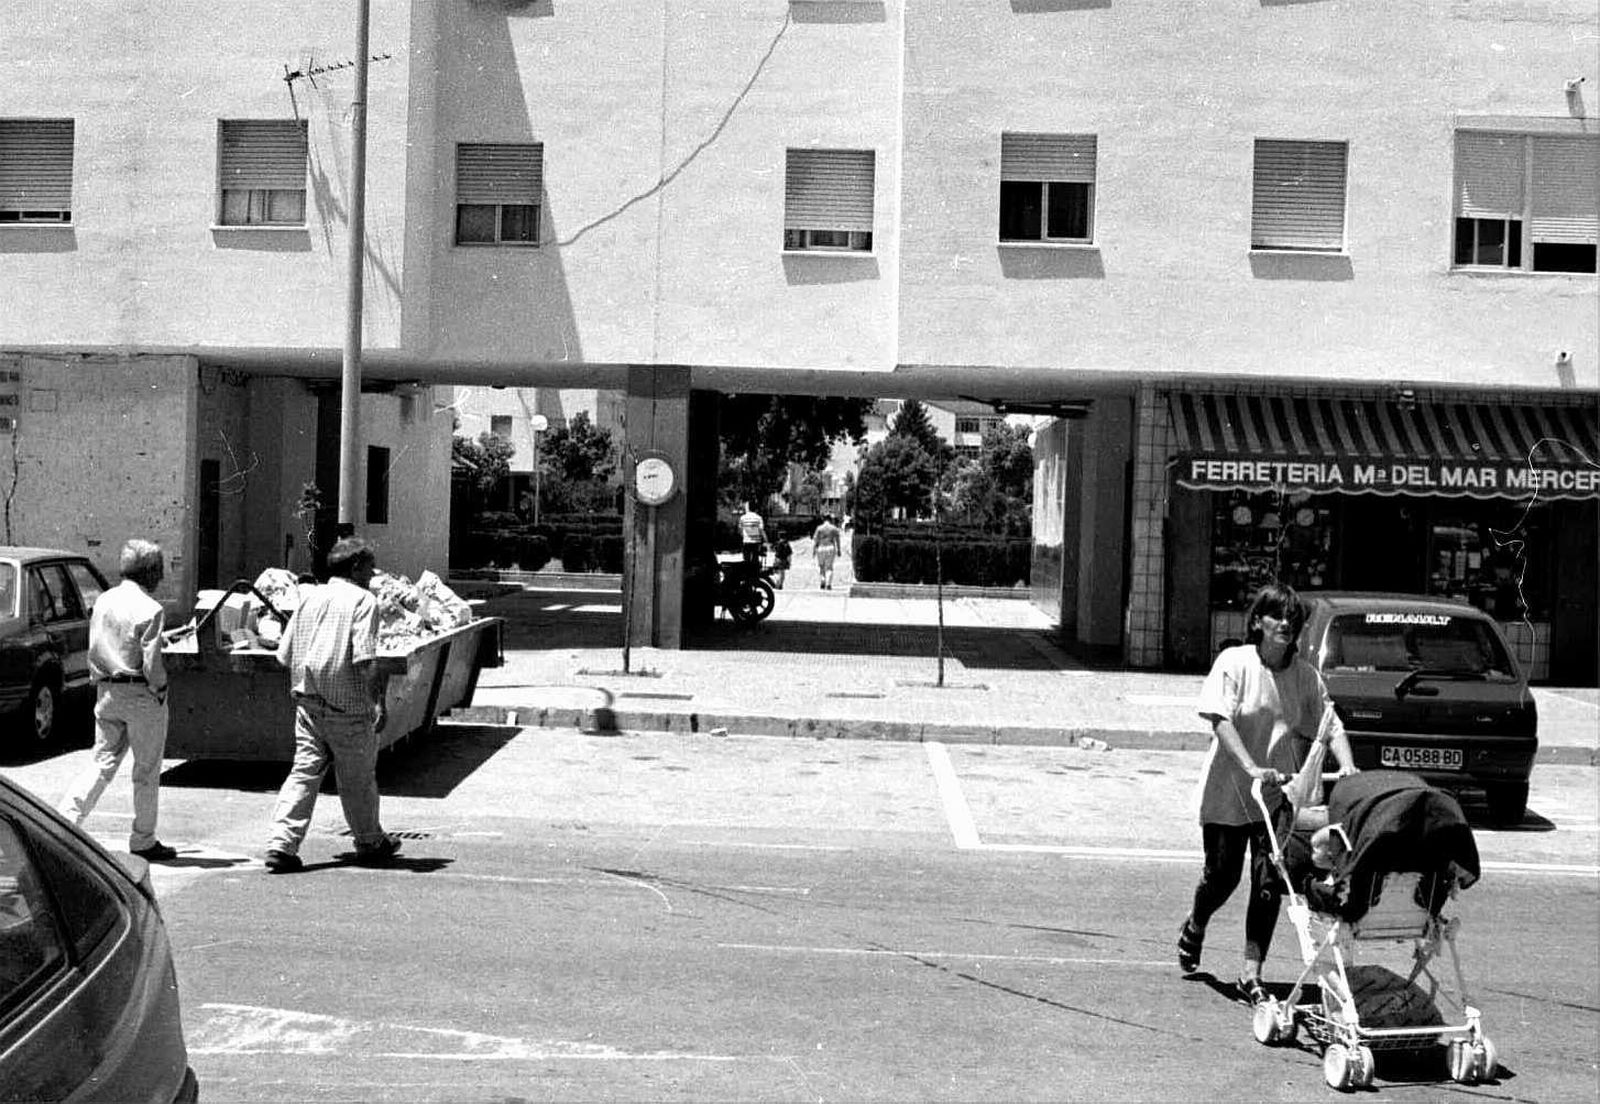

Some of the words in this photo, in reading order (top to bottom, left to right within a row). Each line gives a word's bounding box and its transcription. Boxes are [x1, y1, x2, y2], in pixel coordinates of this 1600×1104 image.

[1191, 460, 1344, 484] FERRETERIA
[1392, 465, 1437, 485] DEL
[1441, 466, 1497, 487] MAR
[1383, 748, 1400, 761] CA
[1404, 749, 1440, 763] 0588
